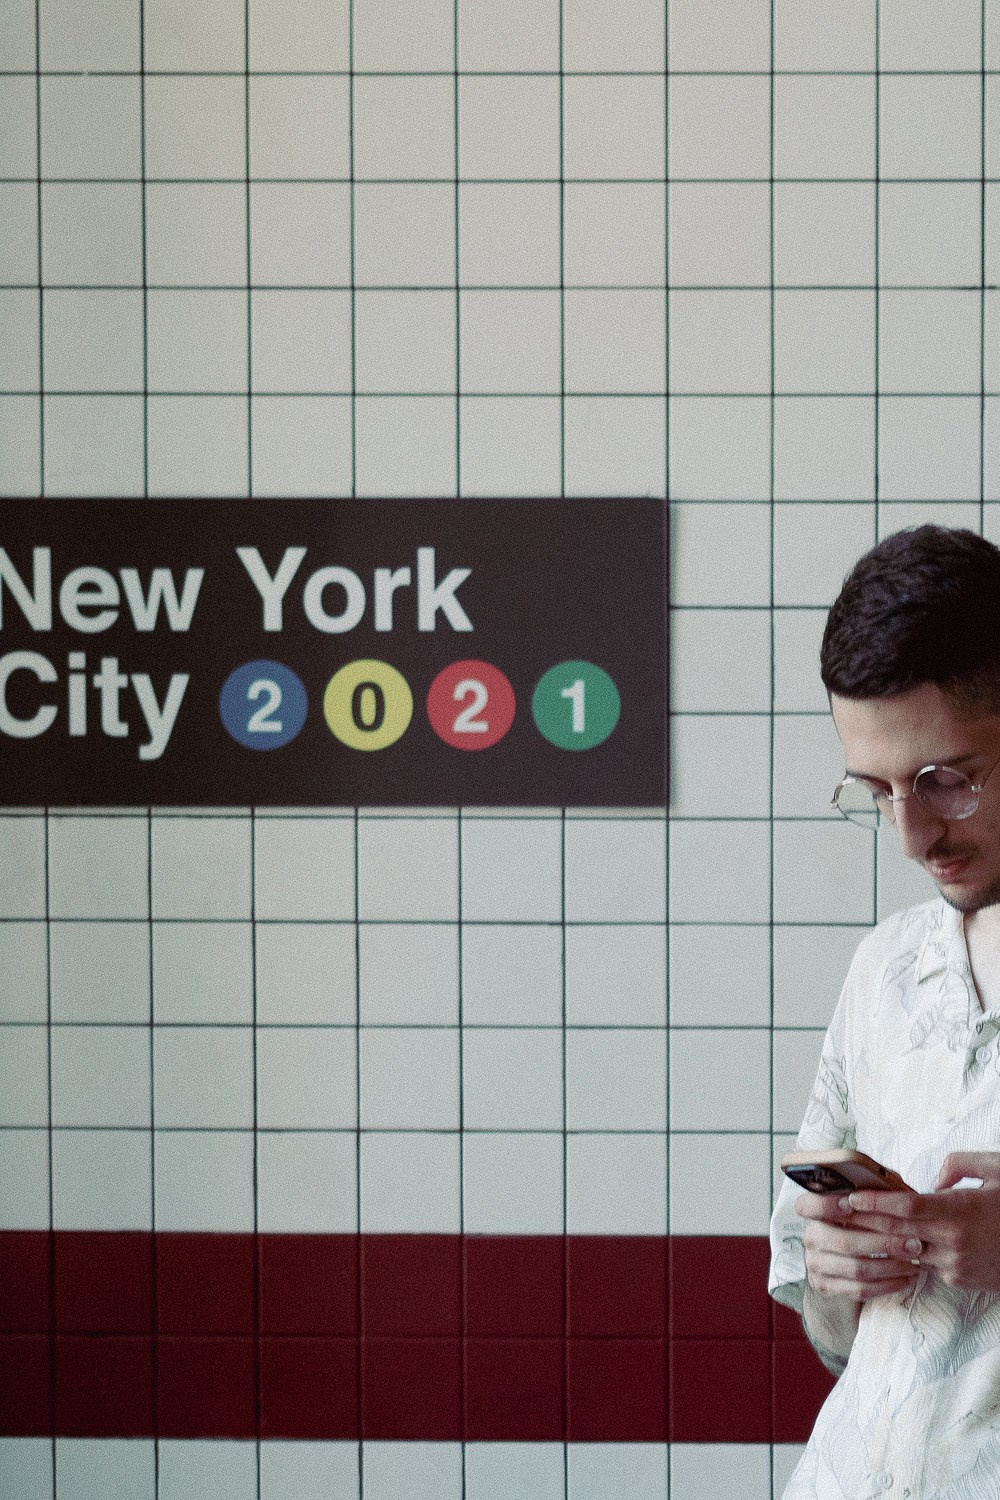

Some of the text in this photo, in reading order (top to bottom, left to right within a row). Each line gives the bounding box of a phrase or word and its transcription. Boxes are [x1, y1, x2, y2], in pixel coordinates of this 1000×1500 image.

[0, 546, 474, 634] New York
[0, 651, 586, 760] City 2 0 2 1
